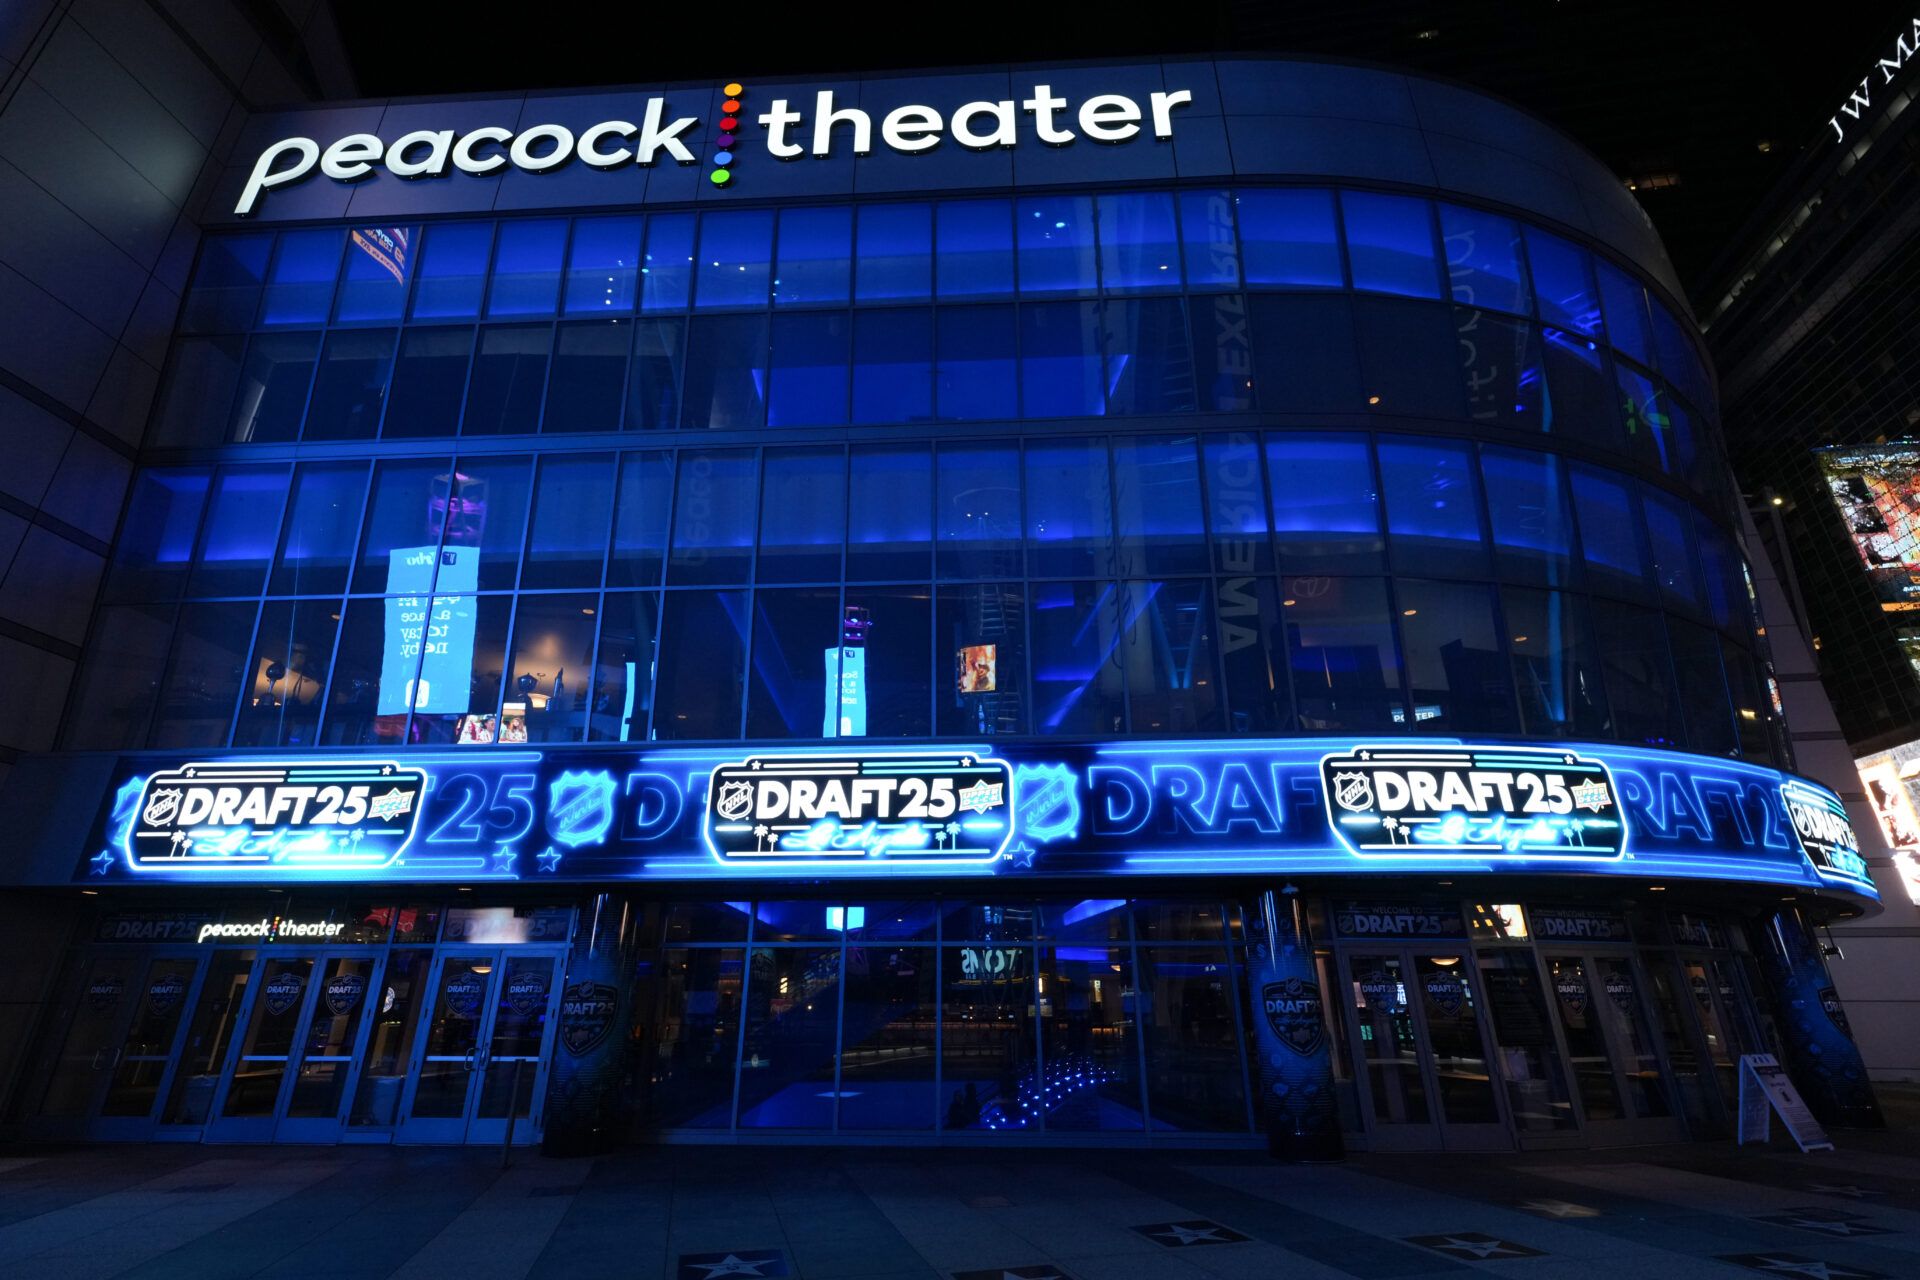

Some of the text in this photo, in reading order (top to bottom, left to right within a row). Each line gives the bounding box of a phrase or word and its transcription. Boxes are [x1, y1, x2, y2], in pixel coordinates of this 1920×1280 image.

[234, 84, 1192, 215] peacock theater
[198, 919, 344, 943] peacock theater
